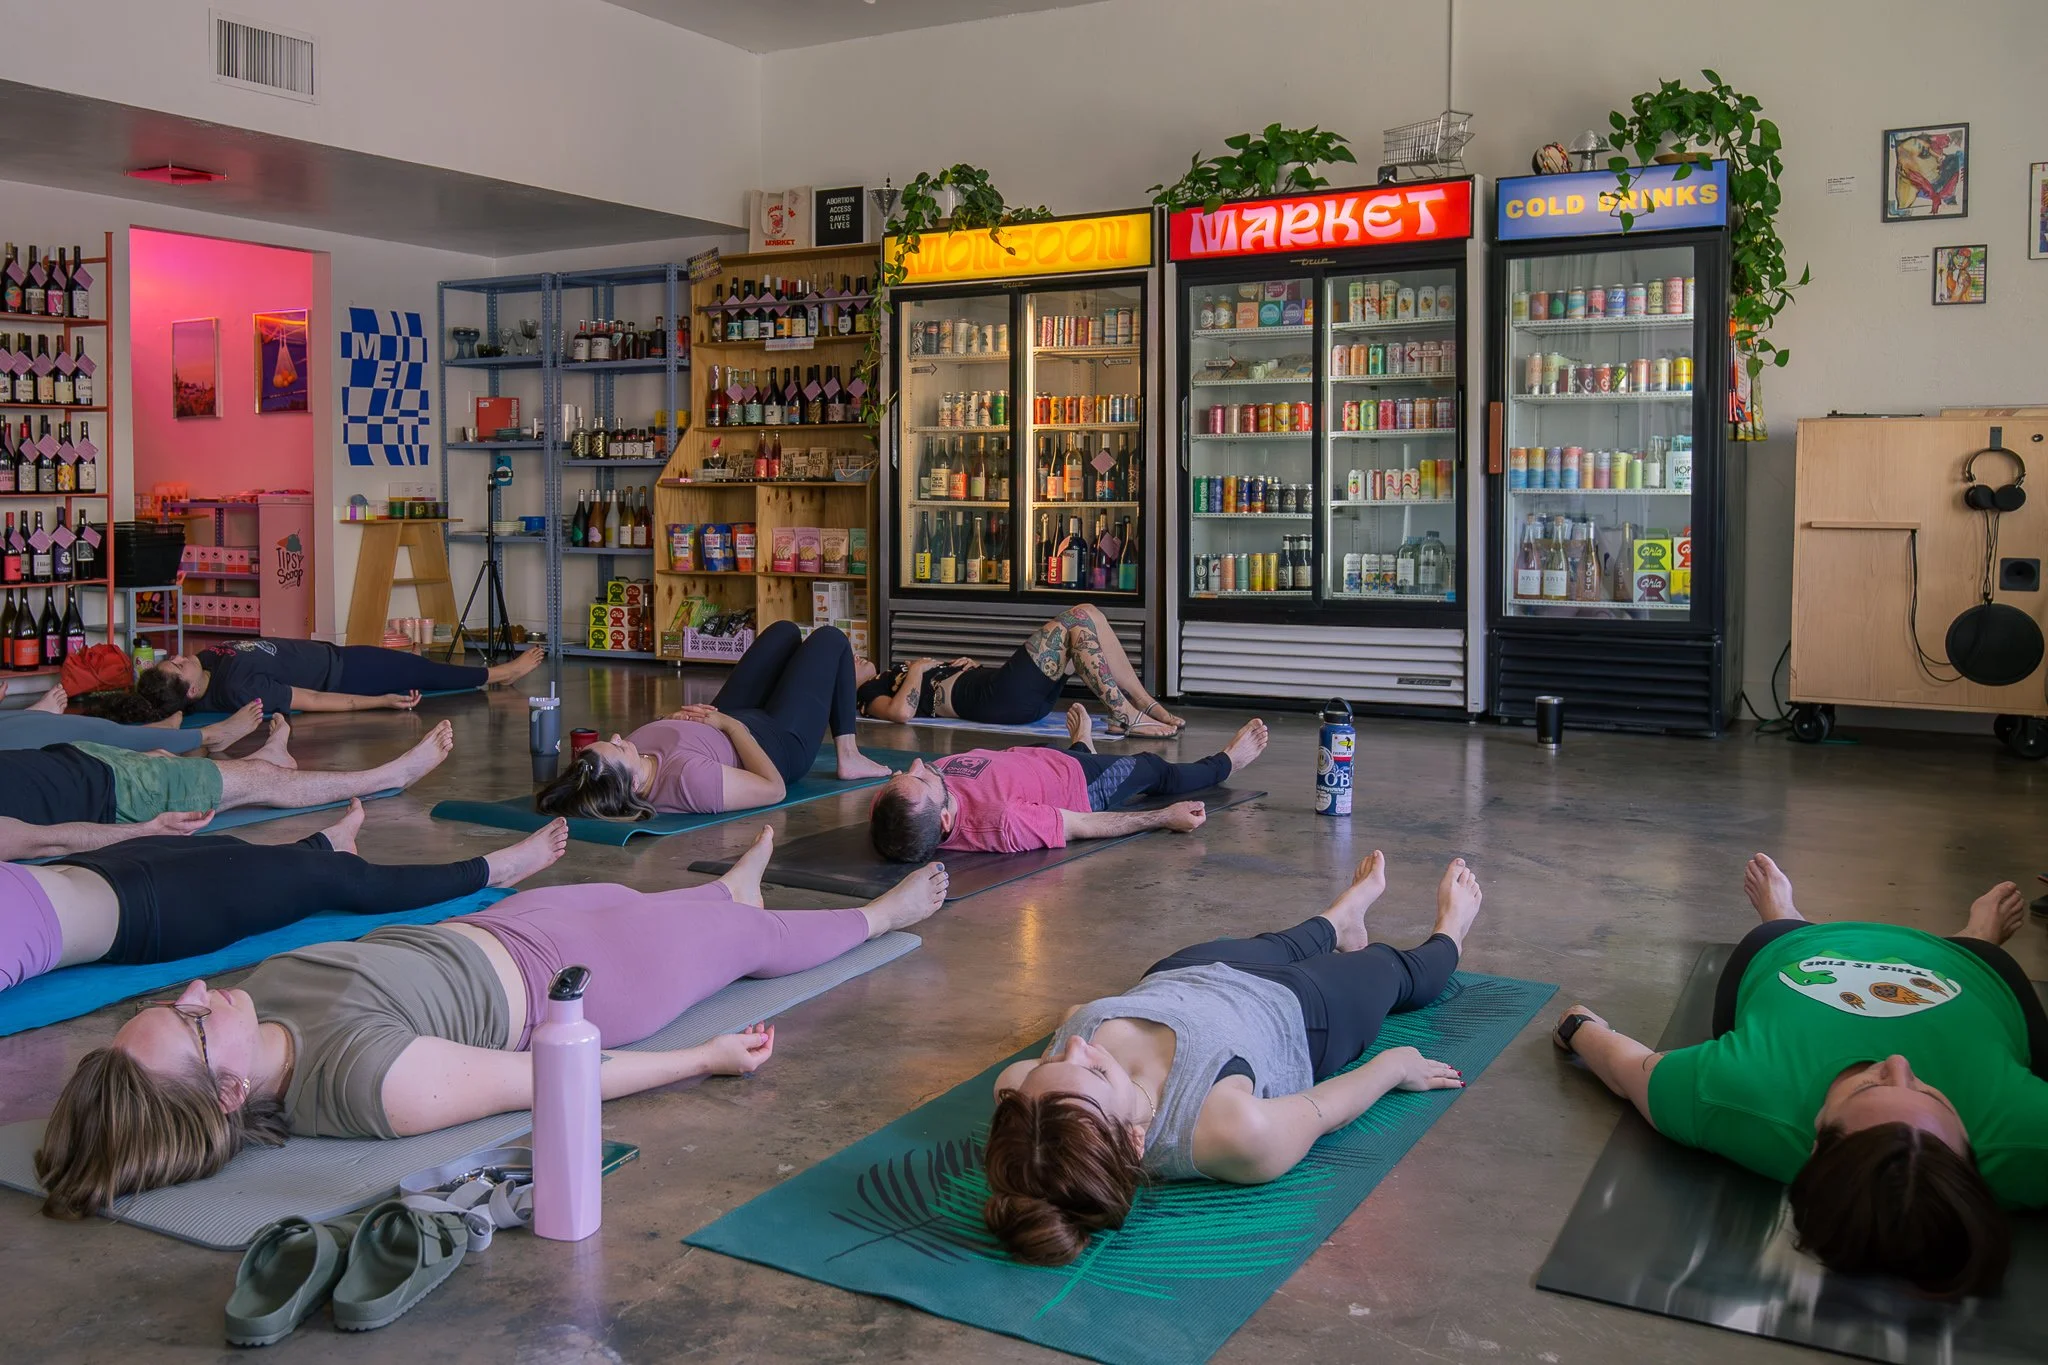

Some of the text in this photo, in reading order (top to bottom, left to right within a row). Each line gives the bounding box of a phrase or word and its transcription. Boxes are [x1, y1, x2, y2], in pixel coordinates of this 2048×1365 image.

[827, 196, 855, 205] ABORTION
[1505, 184, 1719, 219] COLD DRINKS
[829, 205, 852, 214] ACCESS
[829, 214, 850, 222] SAVES
[1189, 188, 1447, 253] MARKET
[830, 222, 850, 230] LIVES
[765, 239, 796, 247] MARKET
[901, 220, 1130, 275] MONSOON
[350, 332, 420, 445] MELT
[1641, 546, 1663, 556] Ghia
[276, 547, 304, 570] TIPSY
[277, 568, 303, 587] Scoop
[1641, 578, 1663, 588] Ghia
[1879, 965, 1928, 977] THIS
